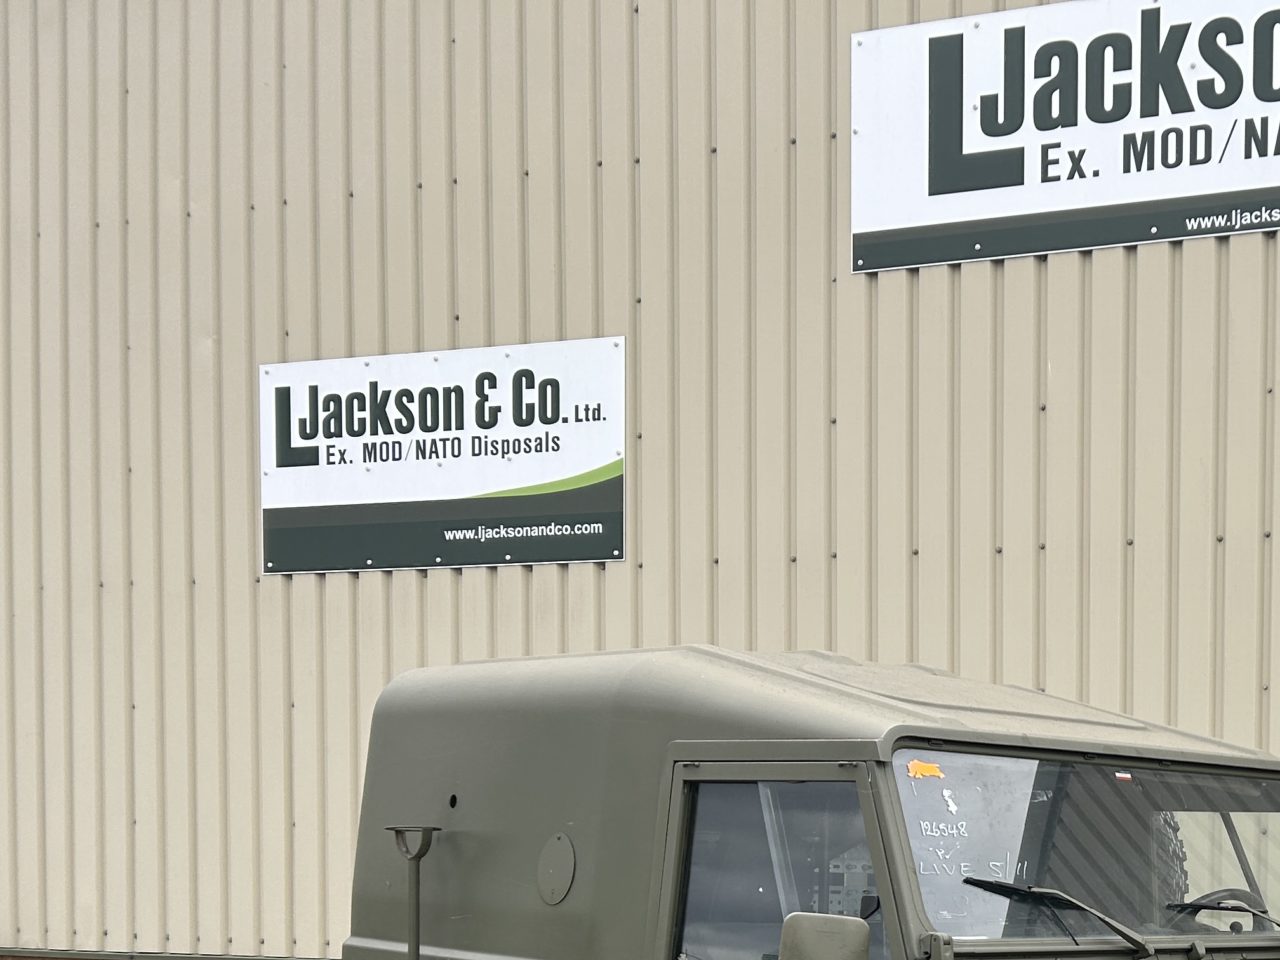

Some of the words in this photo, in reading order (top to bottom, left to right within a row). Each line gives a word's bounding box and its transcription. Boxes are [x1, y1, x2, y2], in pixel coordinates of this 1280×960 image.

[1040, 141, 1100, 184] Ex.
[274, 380, 464, 468] LJackson
[475, 371, 502, 430] &
[512, 368, 569, 428] Co.
[574, 403, 607, 424] Ltd.
[325, 444, 354, 466] Ex.
[362, 436, 462, 464] MOD/NATO
[471, 431, 561, 460] Disposals
[444, 522, 603, 543] www.ljacksonandco.com
[920, 820, 969, 838] 126548
[920, 860, 977, 877] LIVE
